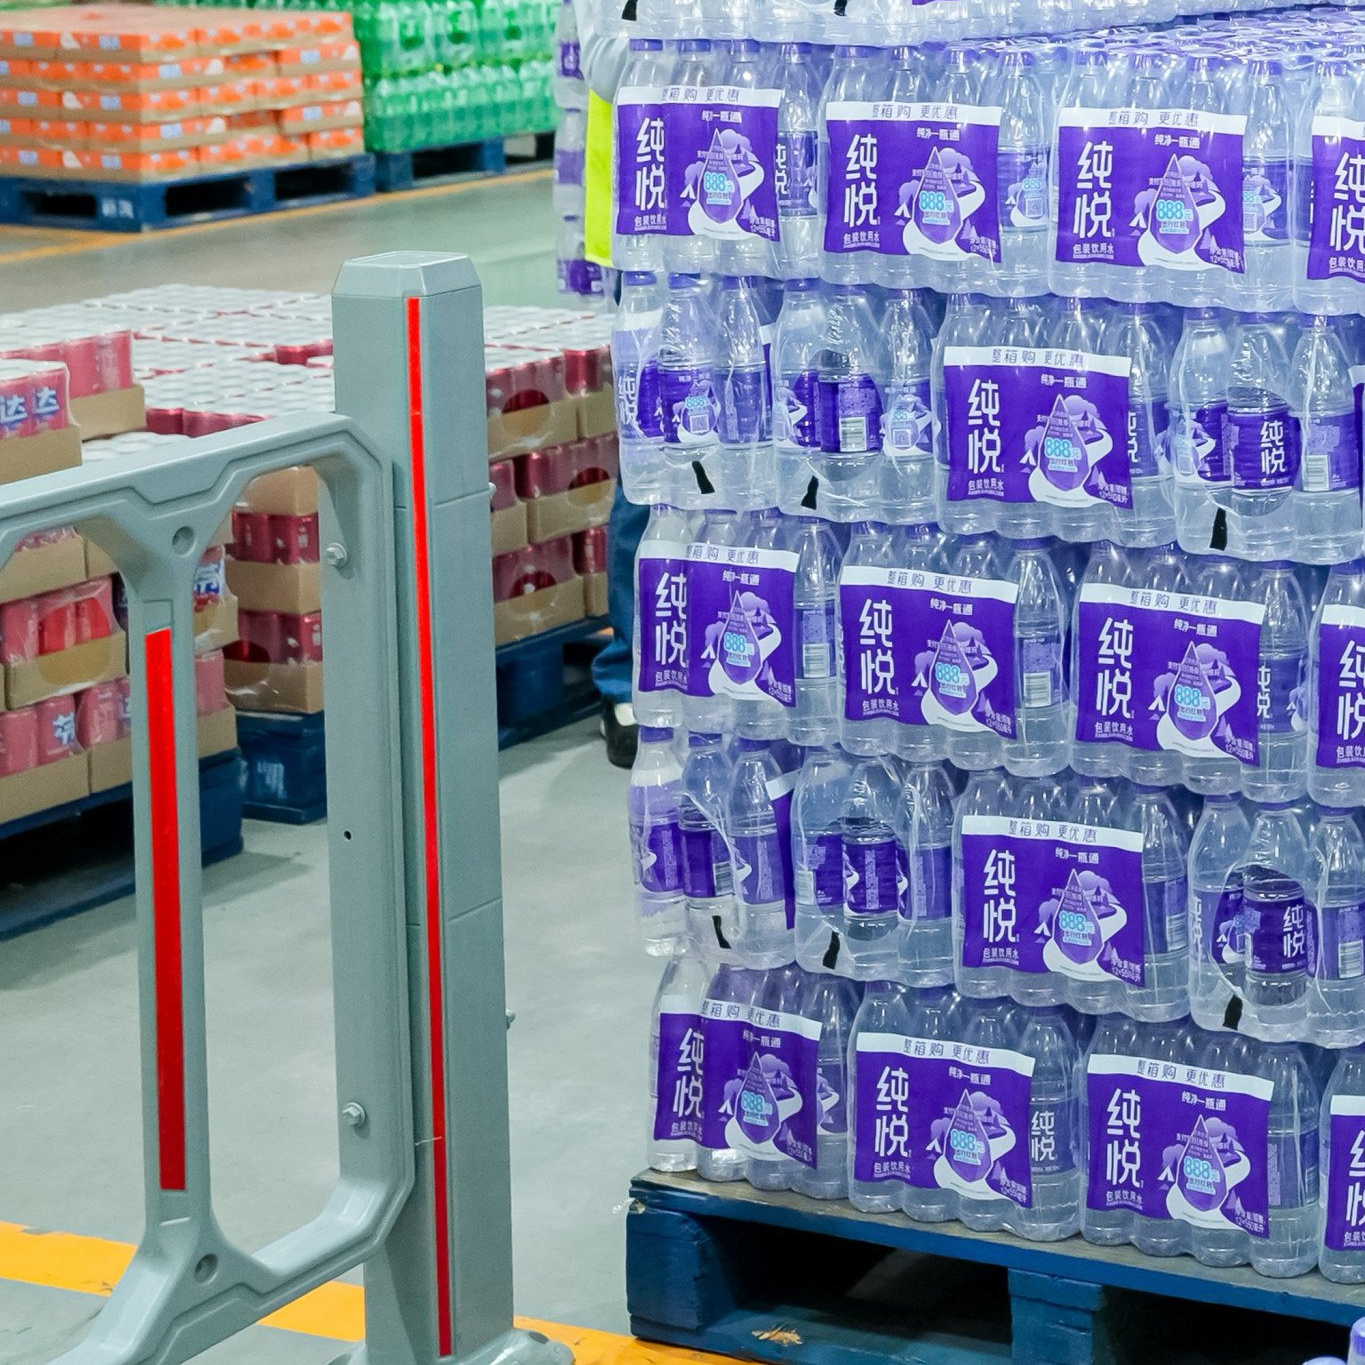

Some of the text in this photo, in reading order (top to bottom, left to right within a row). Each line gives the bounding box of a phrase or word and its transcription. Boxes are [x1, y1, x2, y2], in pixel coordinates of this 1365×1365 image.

[704, 89, 738, 102] 更优惠
[920, 105, 958, 119] 更优惠
[1158, 111, 1198, 126] 更优惠
[636, 118, 665, 210] 纯悦
[846, 134, 877, 226] 纯悦
[1076, 142, 1112, 237] 纯悦
[1043, 351, 1083, 367] 更优惠
[968, 378, 1002, 473] 纯悦
[1260, 421, 1286, 473] 纯悦
[727, 549, 757, 565] 更优惠
[933, 576, 969, 593] 更优惠
[1178, 596, 1216, 614] 更优惠
[656, 572, 686, 668] 纯悦
[860, 598, 896, 695] 纯悦
[1097, 617, 1133, 718] 纯悦
[1058, 825, 1096, 842] 更优惠
[983, 848, 1016, 943] 纯悦
[1282, 906, 1304, 958] 纯悦
[745, 1008, 779, 1028] 更优惠
[678, 1027, 703, 1120] 纯悦
[952, 1046, 989, 1064] 更优惠
[1186, 1069, 1224, 1088] 更优惠
[876, 1066, 908, 1158] 纯悦
[1031, 1111, 1056, 1160] 纯悦
[1106, 1088, 1141, 1187] 纯悦
